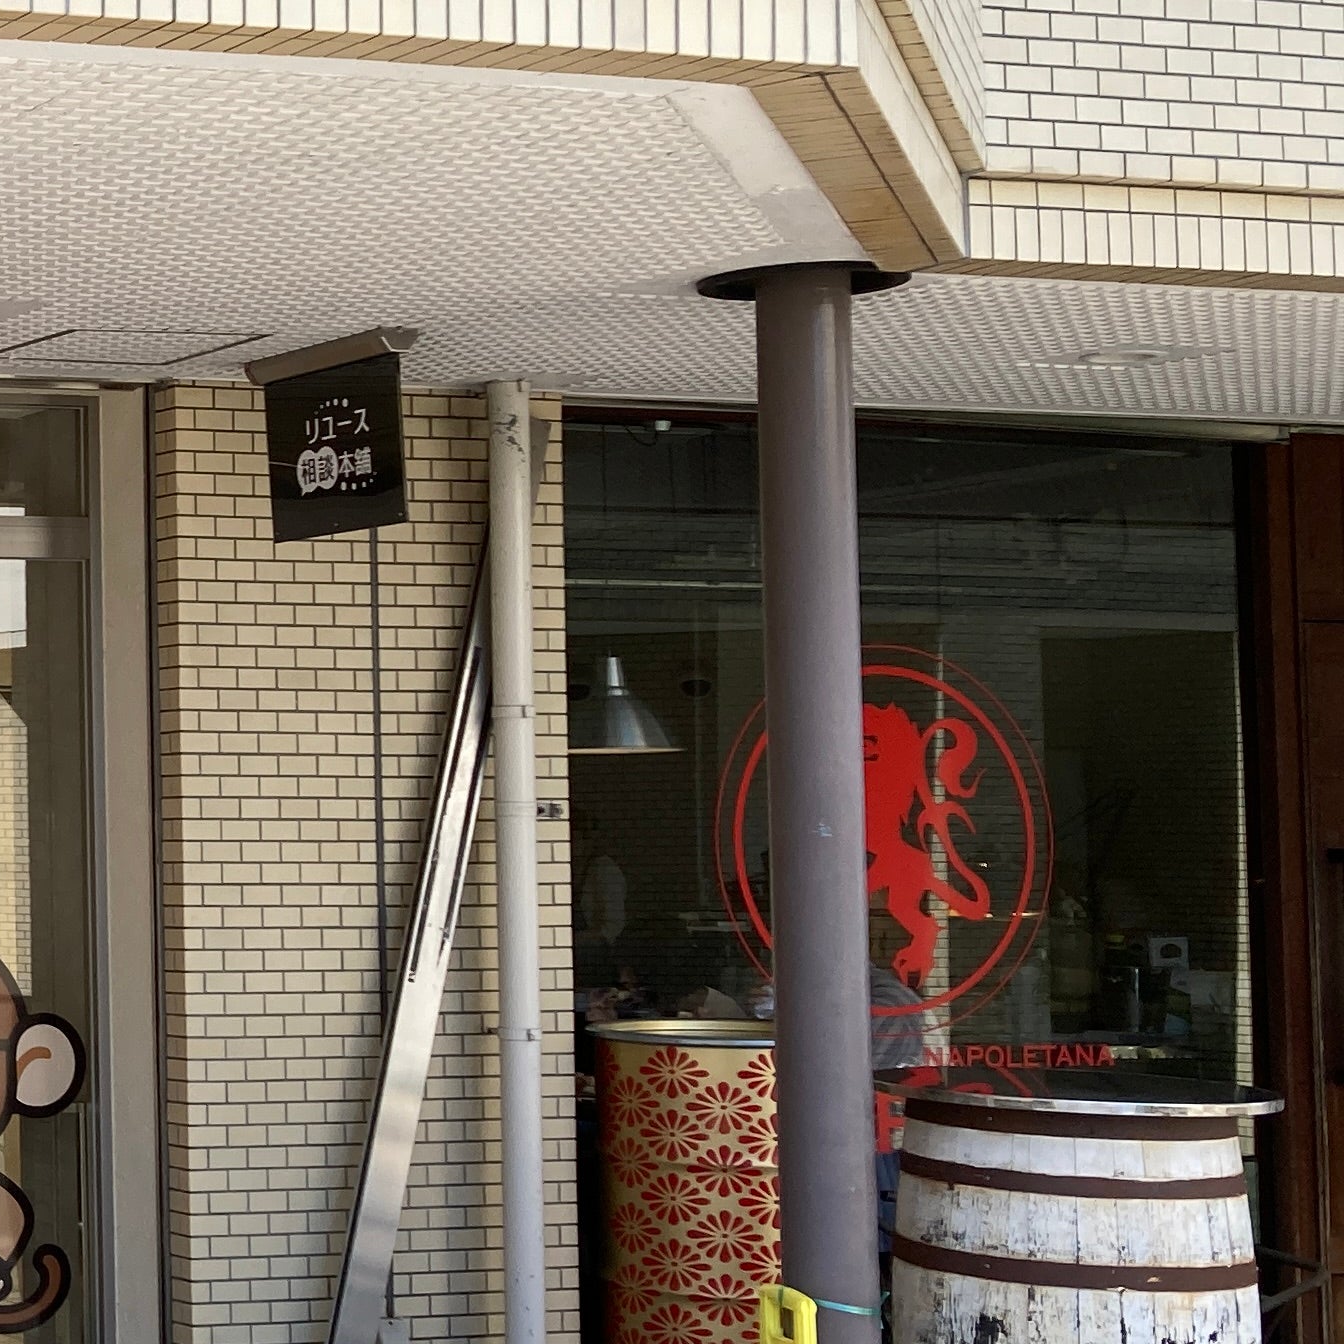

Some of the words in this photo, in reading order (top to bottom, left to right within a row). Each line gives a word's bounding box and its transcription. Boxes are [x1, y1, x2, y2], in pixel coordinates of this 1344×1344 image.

[305, 408, 370, 445] リユース
[301, 446, 372, 485] 相談本舗
[923, 1042, 1116, 1070] NAPOLETANA
